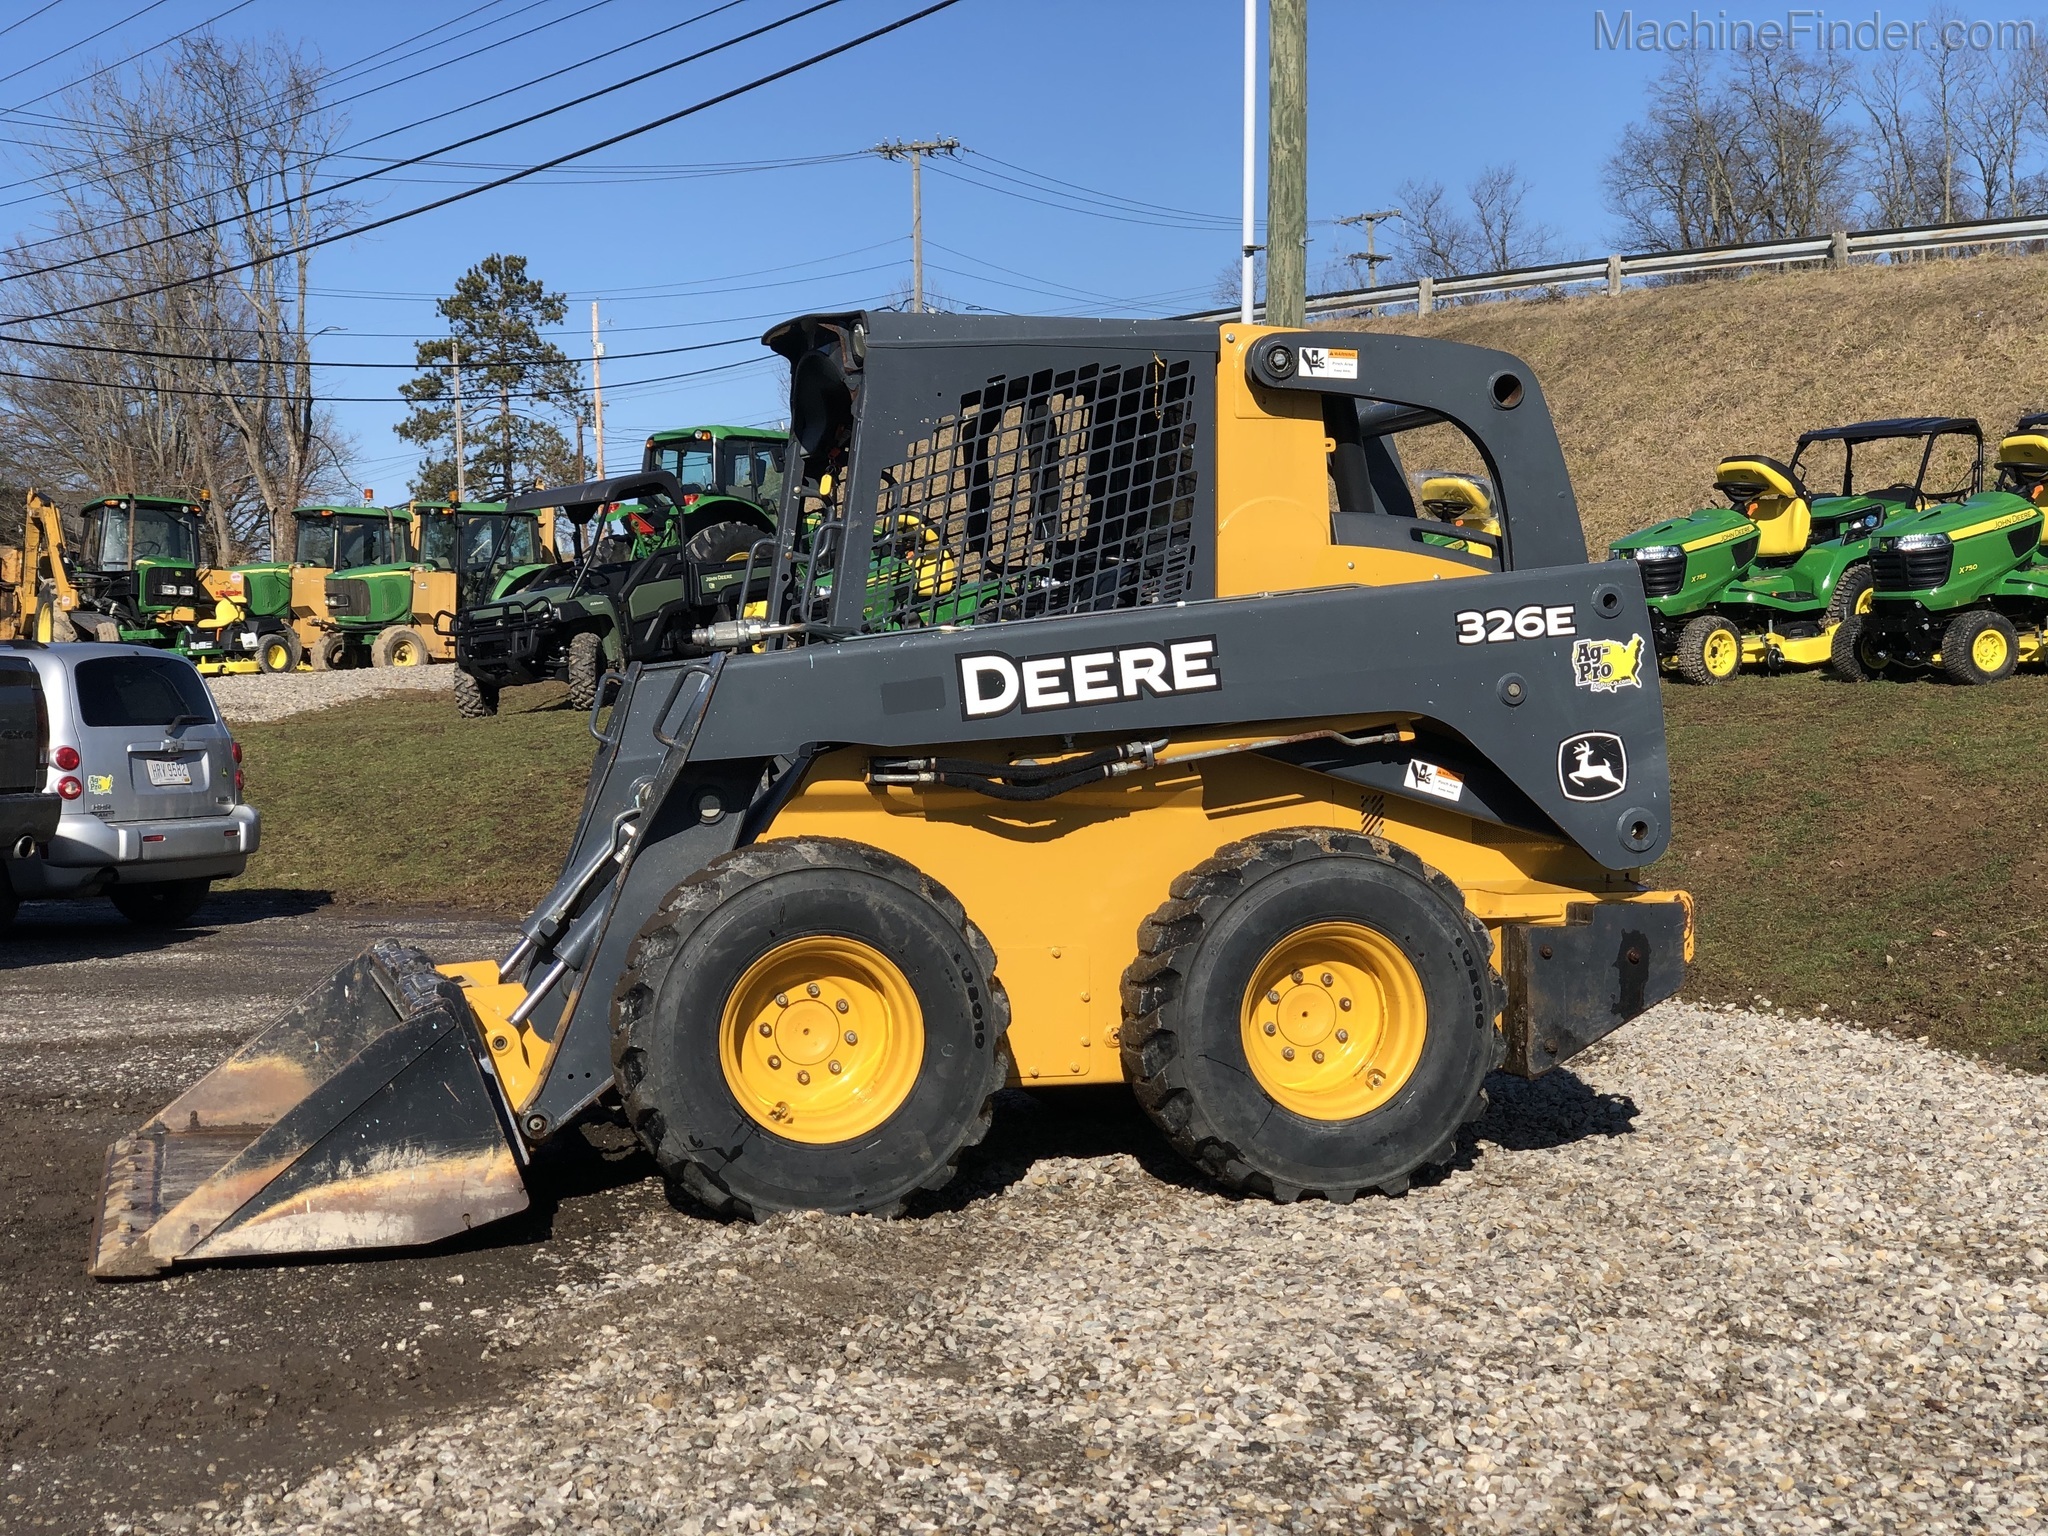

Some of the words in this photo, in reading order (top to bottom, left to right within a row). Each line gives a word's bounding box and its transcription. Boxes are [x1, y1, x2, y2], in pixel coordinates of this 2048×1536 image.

[1994, 520, 2012, 531] JOHN
[2011, 510, 2032, 522] DEERE
[1720, 532, 1735, 543] JOHN
[1959, 563, 1978, 574] X750
[1456, 604, 1577, 645] 326E
[1576, 643, 1609, 664] Ag-
[960, 639, 1218, 716] DEERE
[1578, 662, 1612, 682] Pro
